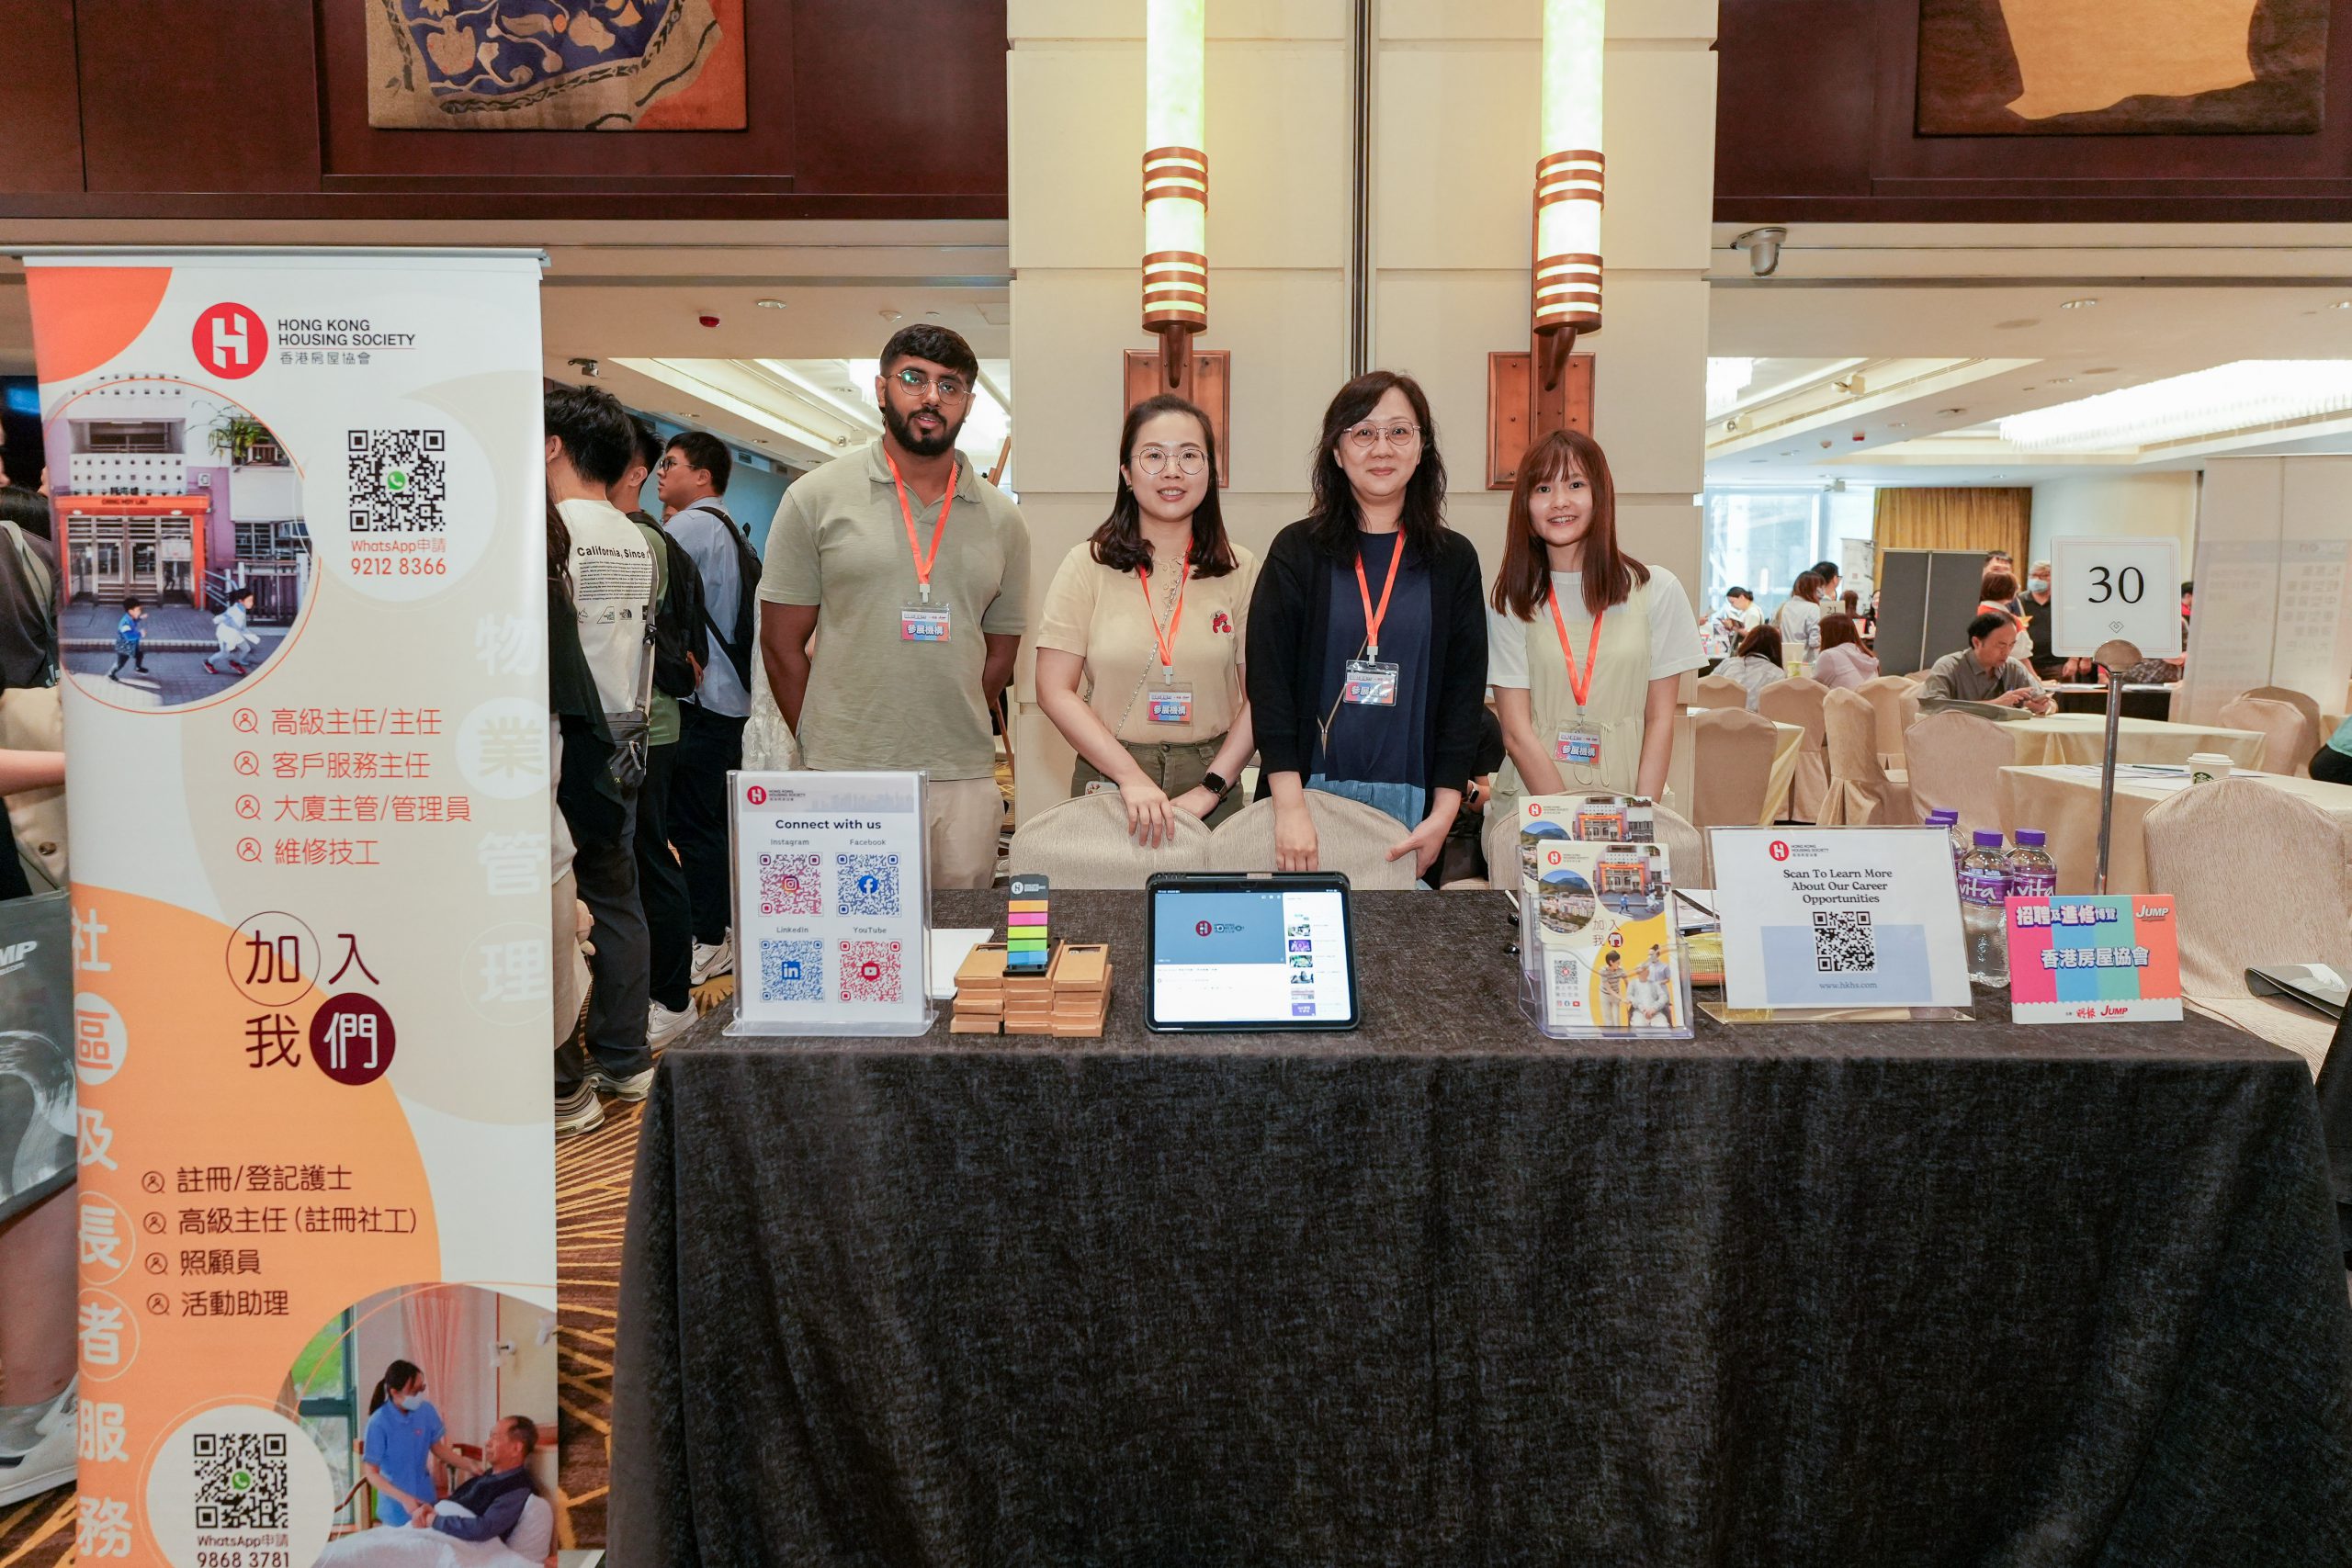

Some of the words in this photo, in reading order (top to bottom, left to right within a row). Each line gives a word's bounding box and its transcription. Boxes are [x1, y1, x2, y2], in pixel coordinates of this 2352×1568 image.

[278, 320, 322, 332] HONG
[327, 320, 370, 332] KONG
[278, 333, 347, 346] HOUSING
[352, 333, 415, 346] SOCIETY
[279, 351, 371, 366] 香港房屋協會
[351, 537, 447, 554] WhatsApp申請
[577, 546, 624, 558] California,
[624, 548, 646, 558] Since
[351, 558, 392, 575] 9212
[400, 558, 447, 575] 8366
[2088, 566, 2144, 604] 30
[271, 707, 443, 736] 高級主任/主任
[272, 750, 431, 780] 客戶服務主任
[273, 795, 472, 823] 大廈主管/管理員
[474, 613, 548, 1003] 物業管理
[775, 818, 830, 829] Connect
[833, 818, 863, 829] with
[866, 820, 882, 829] us
[274, 837, 380, 865] 維修技工
[770, 838, 810, 847] Instagram
[849, 838, 887, 846] Facebook
[1783, 869, 1810, 878] Scan
[1812, 869, 1827, 878] To
[1829, 869, 1861, 878] Learn
[1864, 868, 1893, 878] More
[1792, 881, 1826, 891] About
[1827, 881, 1849, 891] Our
[1852, 881, 1888, 890] Career
[1959, 878, 1996, 900] vita
[2017, 878, 2054, 897] vita
[1803, 894, 1880, 906] Opportunities
[2135, 905, 2169, 918] JUMP
[853, 926, 888, 934] YouTube
[245, 930, 380, 986] 加入
[2041, 946, 2150, 969] 香港房屋協會
[1818, 981, 1878, 990] www.hkhs.com
[2100, 1005, 2129, 1016] JUMP
[244, 1011, 379, 1070] 我們
[177, 1165, 353, 1193] 註冊/登記護士
[179, 1248, 262, 1276] 照顧員
[181, 1290, 289, 1317] 活動助理
[197, 1551, 242, 1568] 9868
[248, 1551, 288, 1568] 3781
